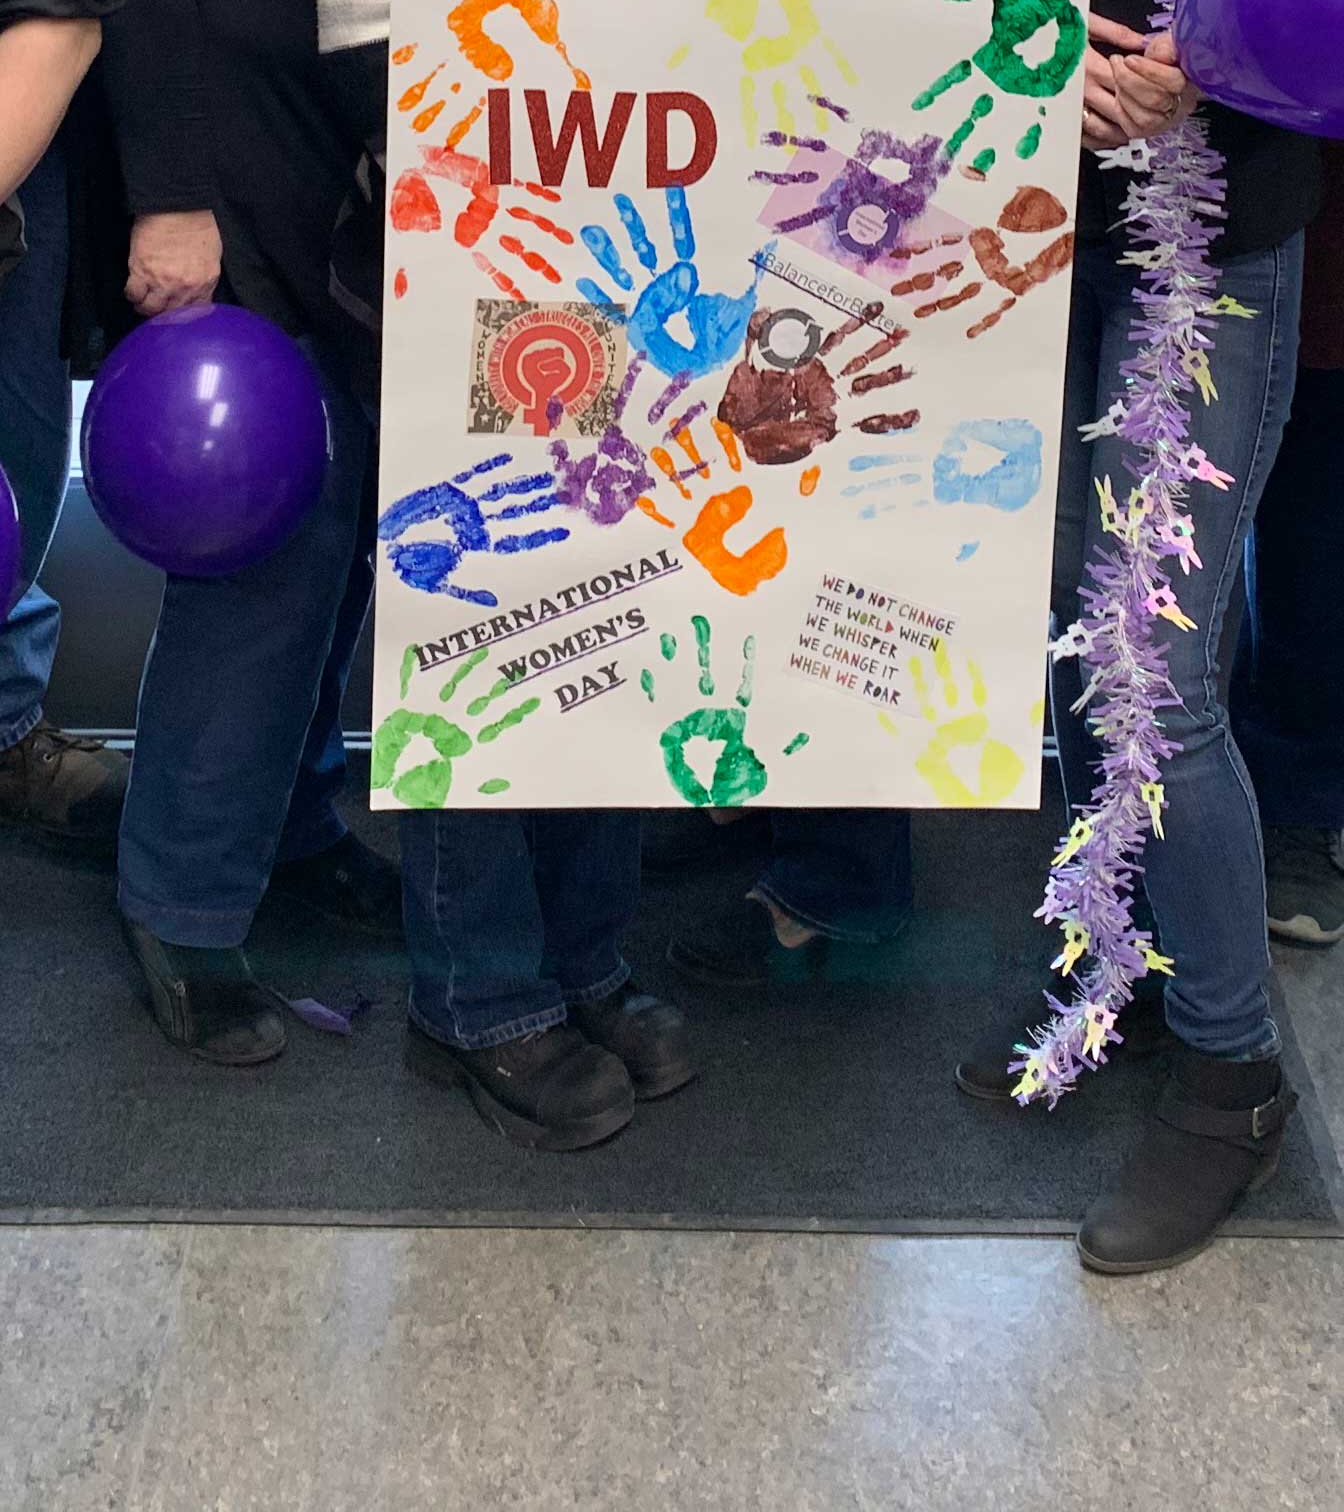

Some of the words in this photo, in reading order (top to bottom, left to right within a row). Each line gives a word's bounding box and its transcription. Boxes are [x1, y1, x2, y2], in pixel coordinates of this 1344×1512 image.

[487, 88, 718, 189] IWD
[414, 548, 680, 667] INTERNATIONAL
[815, 595, 843, 615] THE
[847, 606, 894, 634] WORLD
[899, 626, 940, 652] WHEN
[822, 574, 845, 594] WE
[846, 582, 865, 600] DO
[868, 592, 897, 611] NOT
[899, 604, 955, 636] CHANGE
[497, 607, 646, 683] WOMEN'S
[799, 633, 820, 651] WE
[822, 644, 880, 675] CHANGE
[882, 665, 900, 681] IT
[806, 612, 829, 632] WE
[833, 622, 898, 659] WHISPER
[553, 661, 620, 708] DAY
[790, 653, 831, 680] WHEN
[835, 670, 859, 690] WE
[863, 680, 902, 705] ROAR
